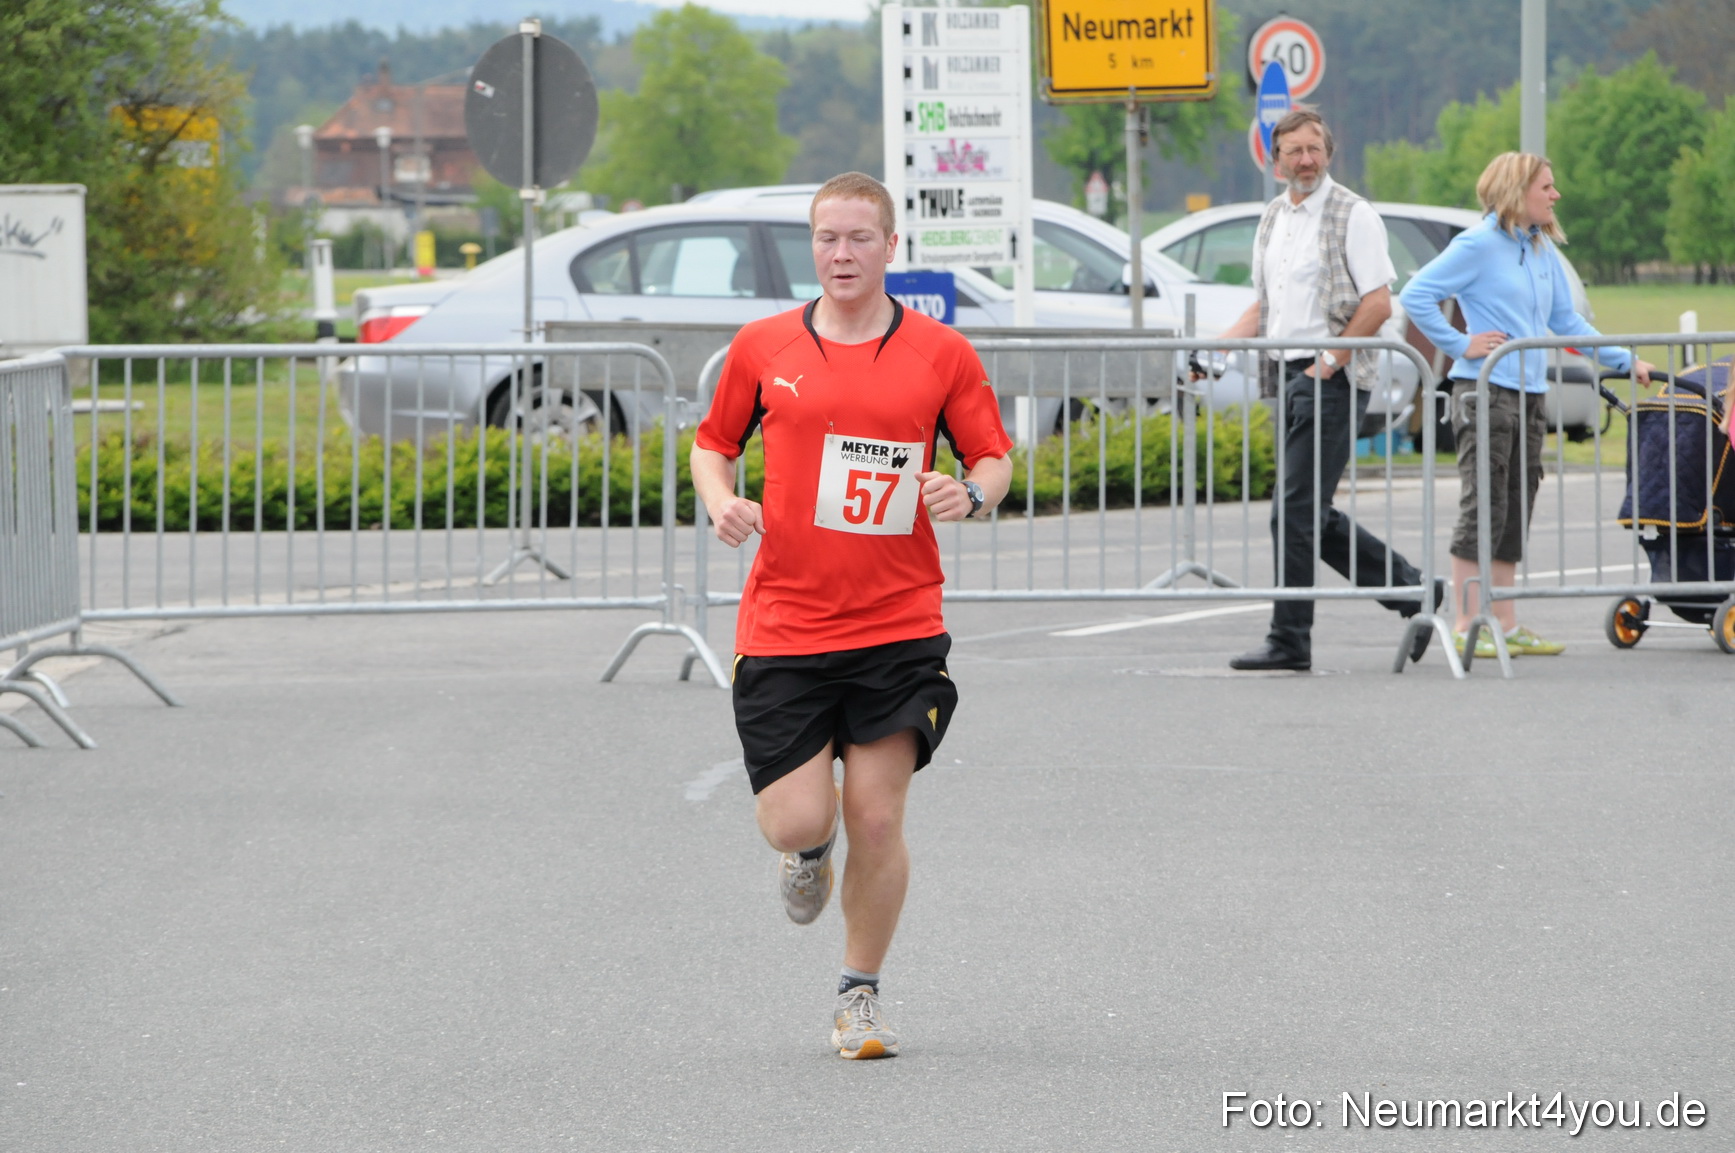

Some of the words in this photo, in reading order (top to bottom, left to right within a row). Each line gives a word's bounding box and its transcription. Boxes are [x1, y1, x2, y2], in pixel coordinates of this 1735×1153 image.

[1063, 9, 1194, 41] Neumarkt
[1108, 53, 1117, 69] 5
[1131, 55, 1154, 68] km
[918, 101, 946, 133] SHB
[919, 189, 964, 218] THULE
[841, 441, 889, 457] MEYER
[841, 453, 889, 466] WERBUNG
[843, 469, 900, 525] 57
